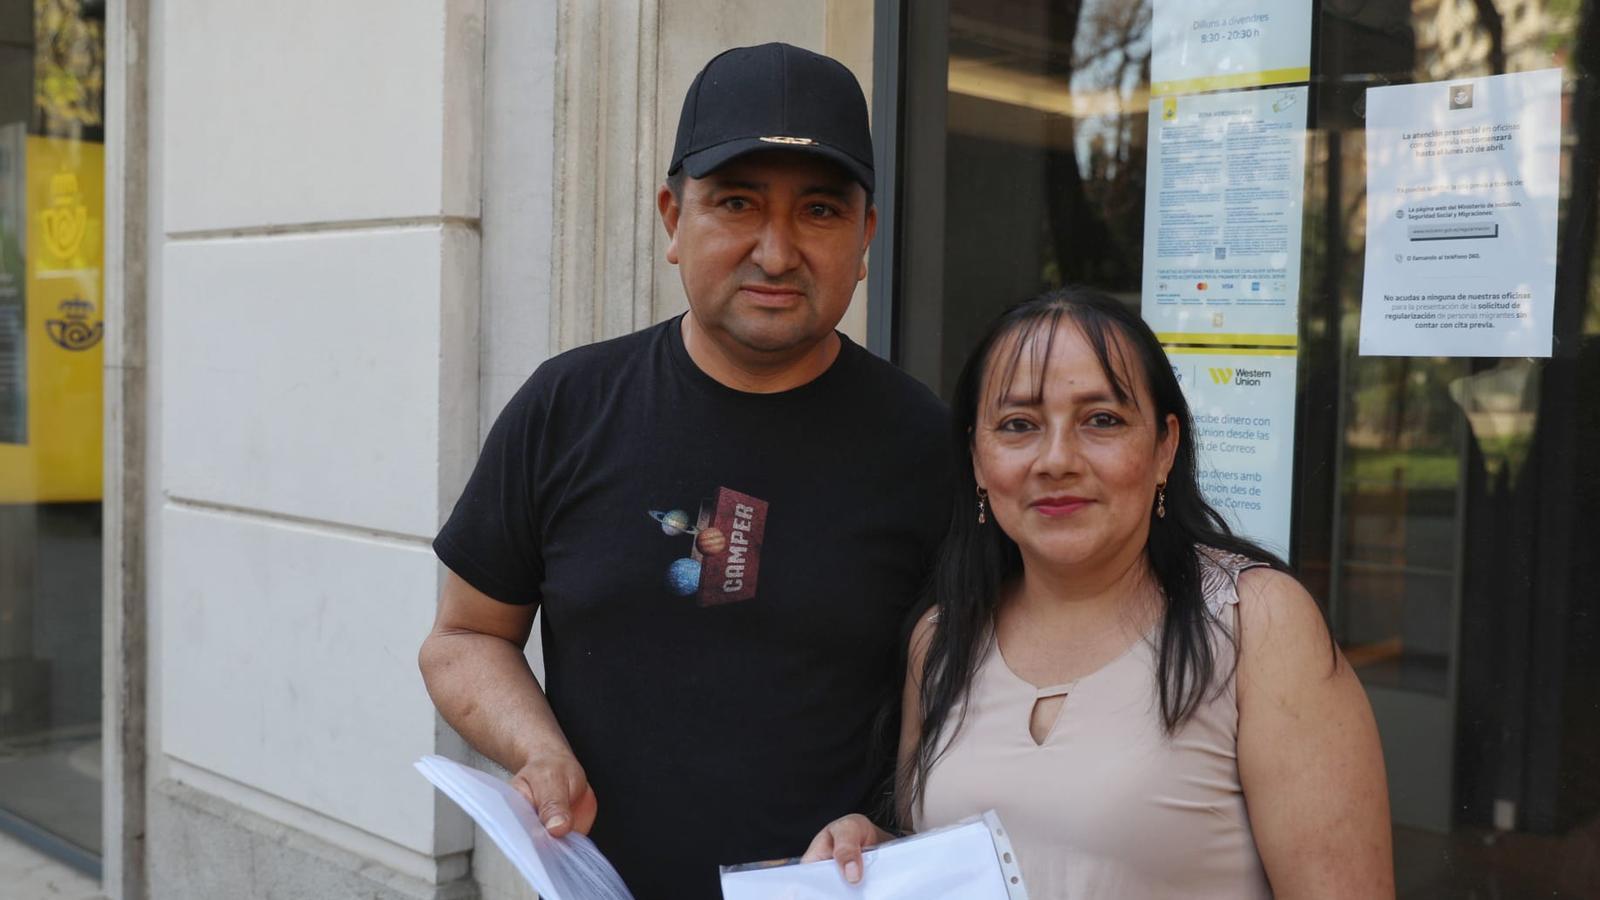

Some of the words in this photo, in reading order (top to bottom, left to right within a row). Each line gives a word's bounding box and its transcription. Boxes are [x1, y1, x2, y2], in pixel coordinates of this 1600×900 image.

[1227, 28, 1252, 40] 20:30
[1412, 130, 1442, 140] atención
[1444, 126, 1480, 136] presencial
[1492, 124, 1520, 132] oficinas
[1486, 144, 1504, 152] abril.
[1427, 293, 1456, 302] ninguna
[1416, 302, 1458, 312] presentación
[1478, 302, 1510, 310] solicitud
[1385, 312, 1436, 320] regularización
[1480, 312, 1515, 320] migrantes
[1470, 321, 1496, 330] previa.
[1235, 368, 1272, 378] Western
[1235, 378, 1261, 386] Union
[1222, 414, 1251, 426] dinero
[1252, 418, 1270, 426] con
[1226, 430, 1254, 440] desde
[1256, 432, 1270, 440] las
[1206, 442, 1218, 451] de
[1220, 442, 1256, 454] Correos
[1240, 472, 1262, 482] amb
[1202, 483, 1228, 494] Union
[1230, 484, 1248, 495] des
[1248, 486, 1261, 496] de
[1212, 498, 1223, 508] de
[1224, 498, 1261, 510] Correos
[723, 502, 754, 592] CAMPER
